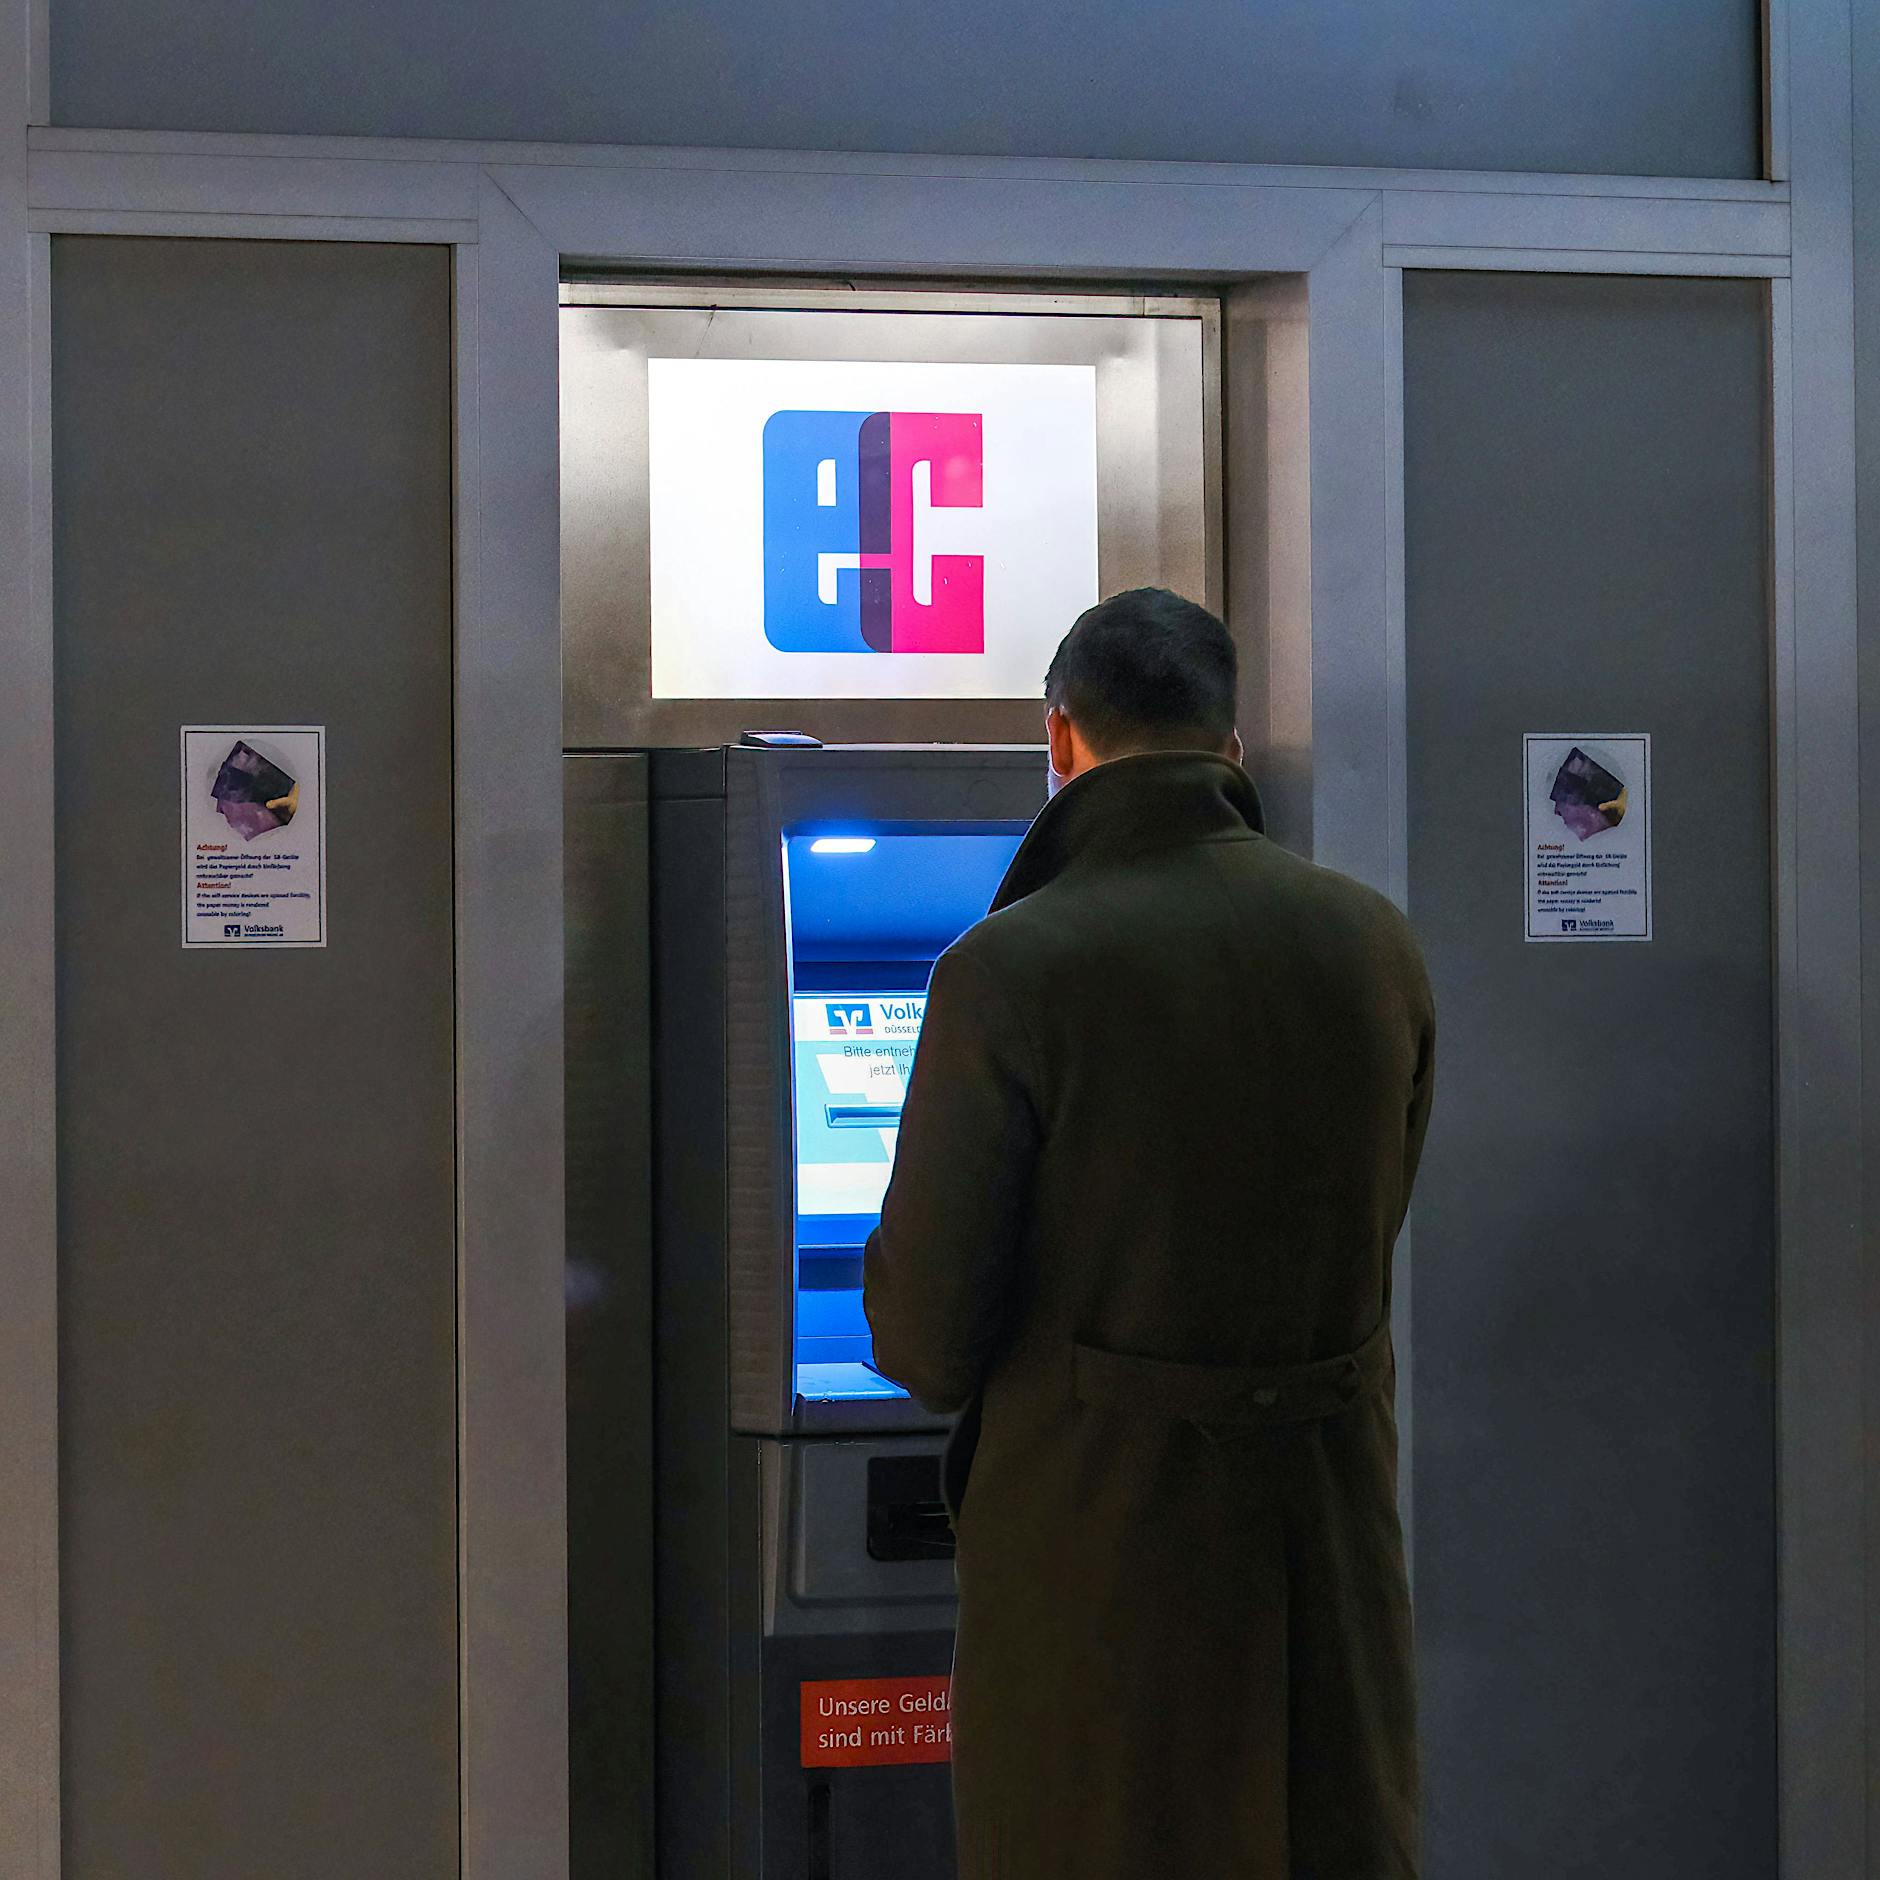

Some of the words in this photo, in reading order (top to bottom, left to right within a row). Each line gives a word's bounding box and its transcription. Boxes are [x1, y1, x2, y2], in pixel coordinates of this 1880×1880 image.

[880, 1002, 923, 1020] Volk
[844, 1046, 871, 1058] Bitte
[869, 1064, 896, 1078] jetzt
[820, 1697, 890, 1716] Unsere
[818, 1726, 862, 1748] sind
[870, 1726, 905, 1746] mit
